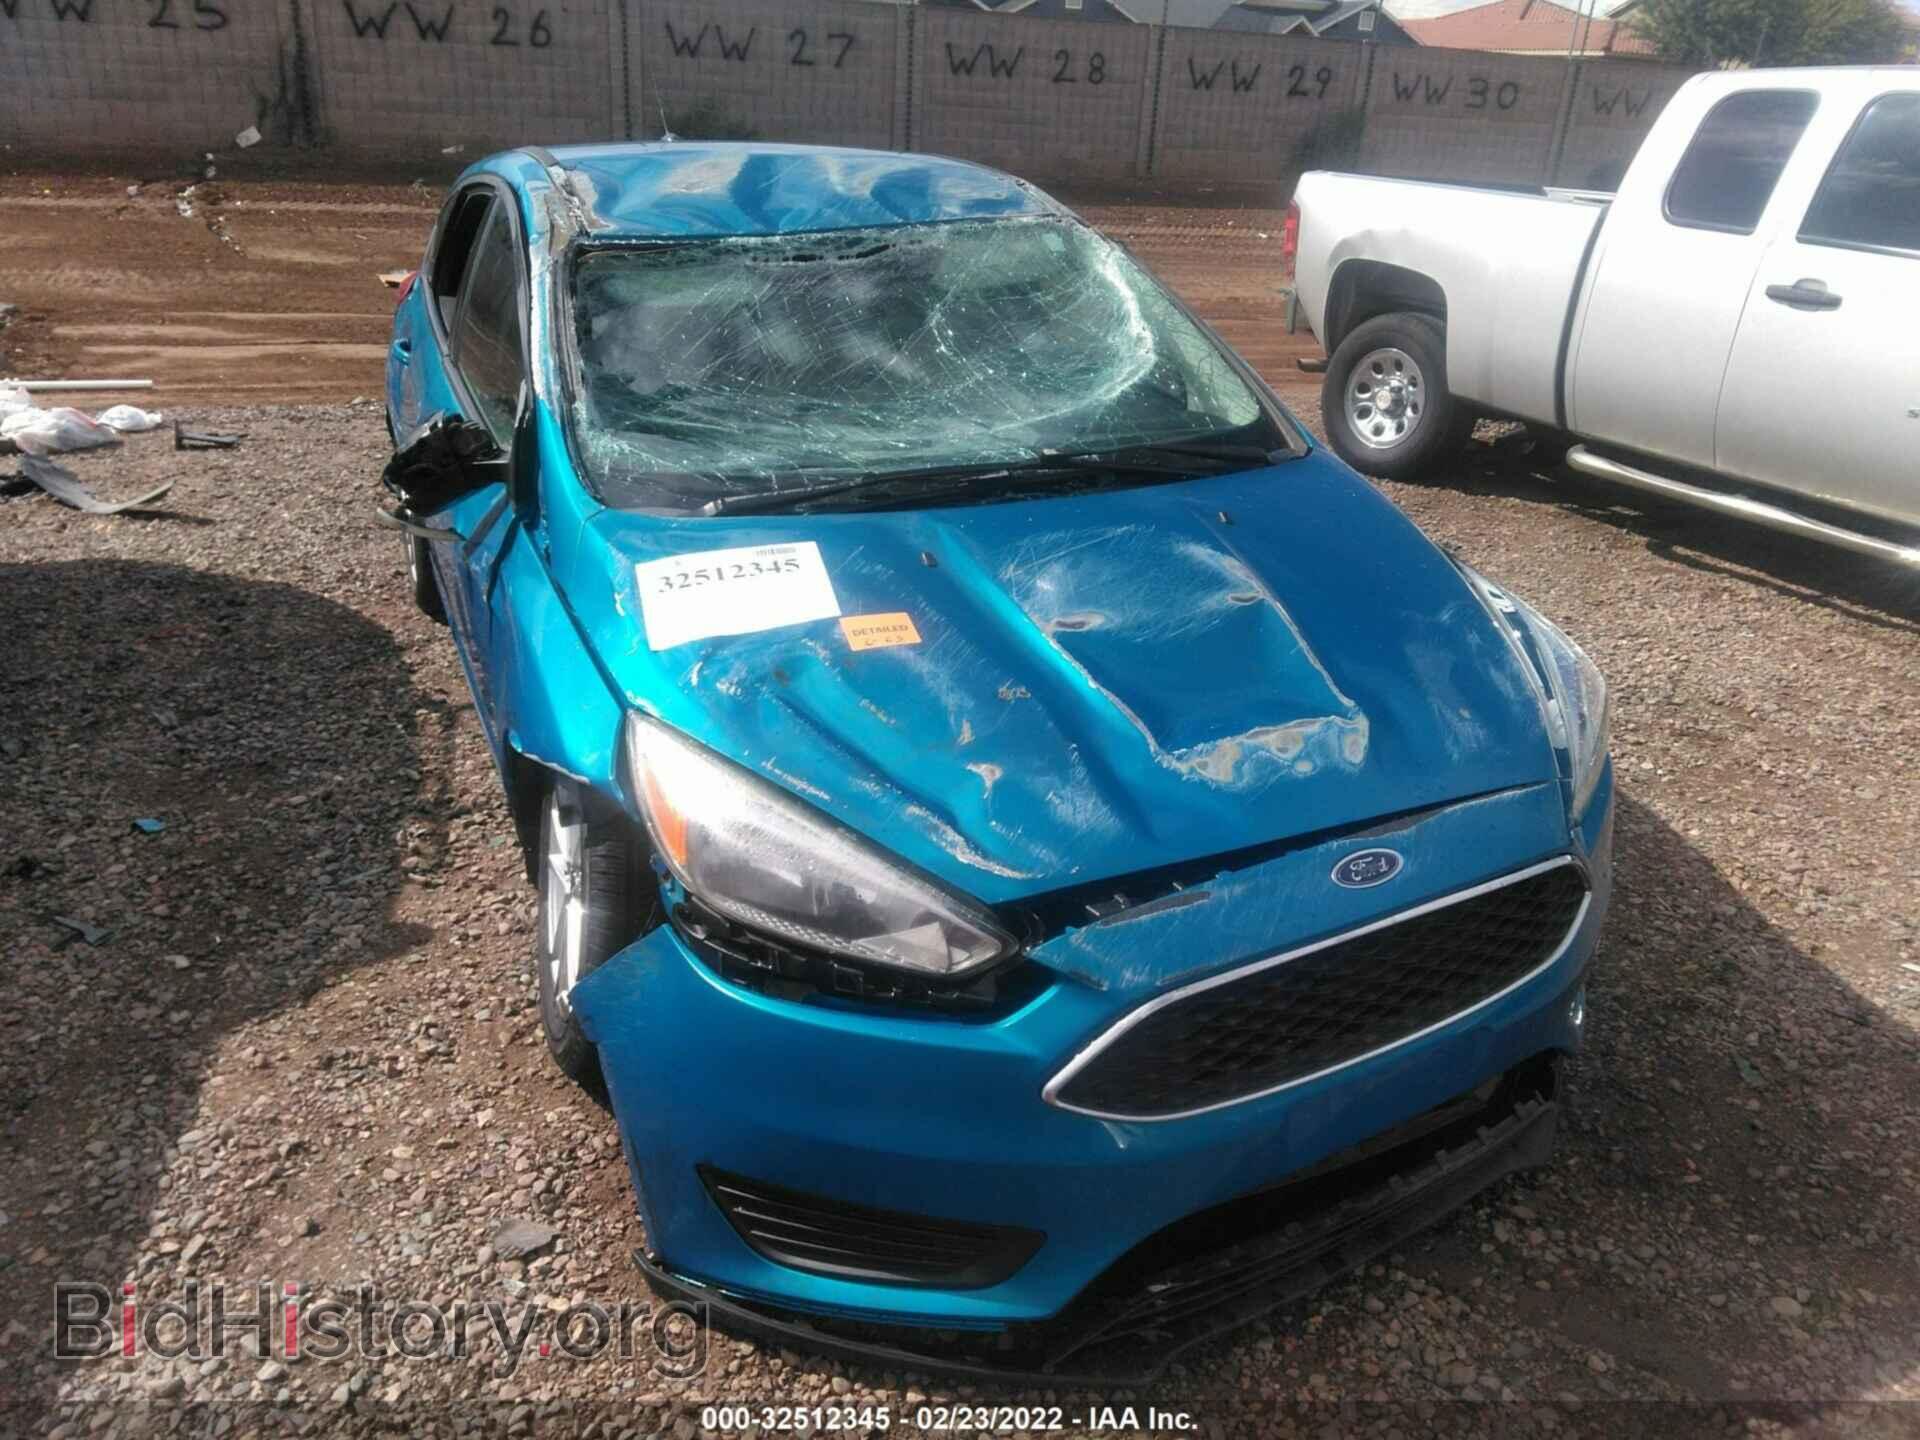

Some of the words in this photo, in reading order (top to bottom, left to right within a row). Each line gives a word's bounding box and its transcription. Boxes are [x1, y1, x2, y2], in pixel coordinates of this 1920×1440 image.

[0, 0, 92, 22] W
[148, 0, 228, 31] 25
[490, 7, 551, 49] 26
[788, 27, 856, 69] 27
[1051, 48, 1106, 85] 28
[1286, 64, 1333, 99] 29
[1463, 77, 1521, 111] 30
[658, 557, 801, 594] 32512345
